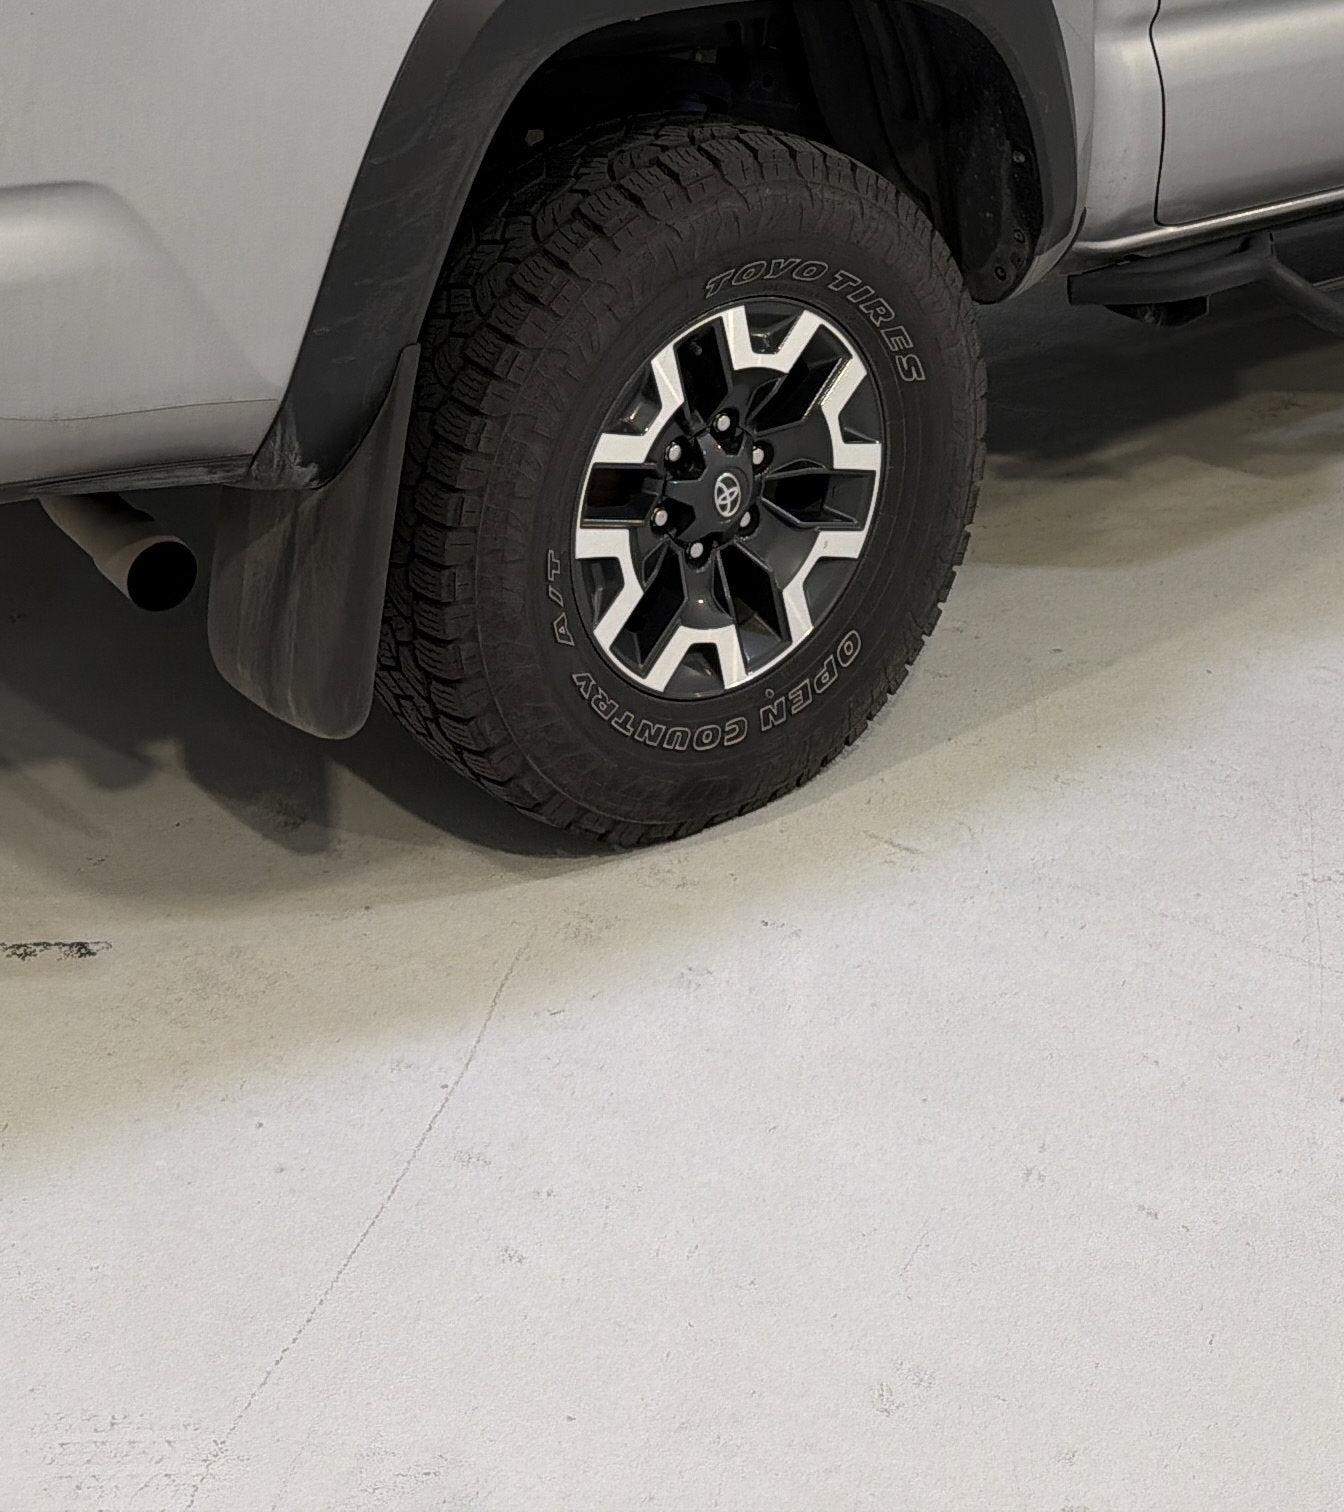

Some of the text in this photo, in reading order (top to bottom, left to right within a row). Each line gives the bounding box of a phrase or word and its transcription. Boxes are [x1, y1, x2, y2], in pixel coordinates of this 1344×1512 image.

[705, 258, 926, 382] TOYO TIRES
[547, 549, 862, 751] OPEN COUNTRY A/T
